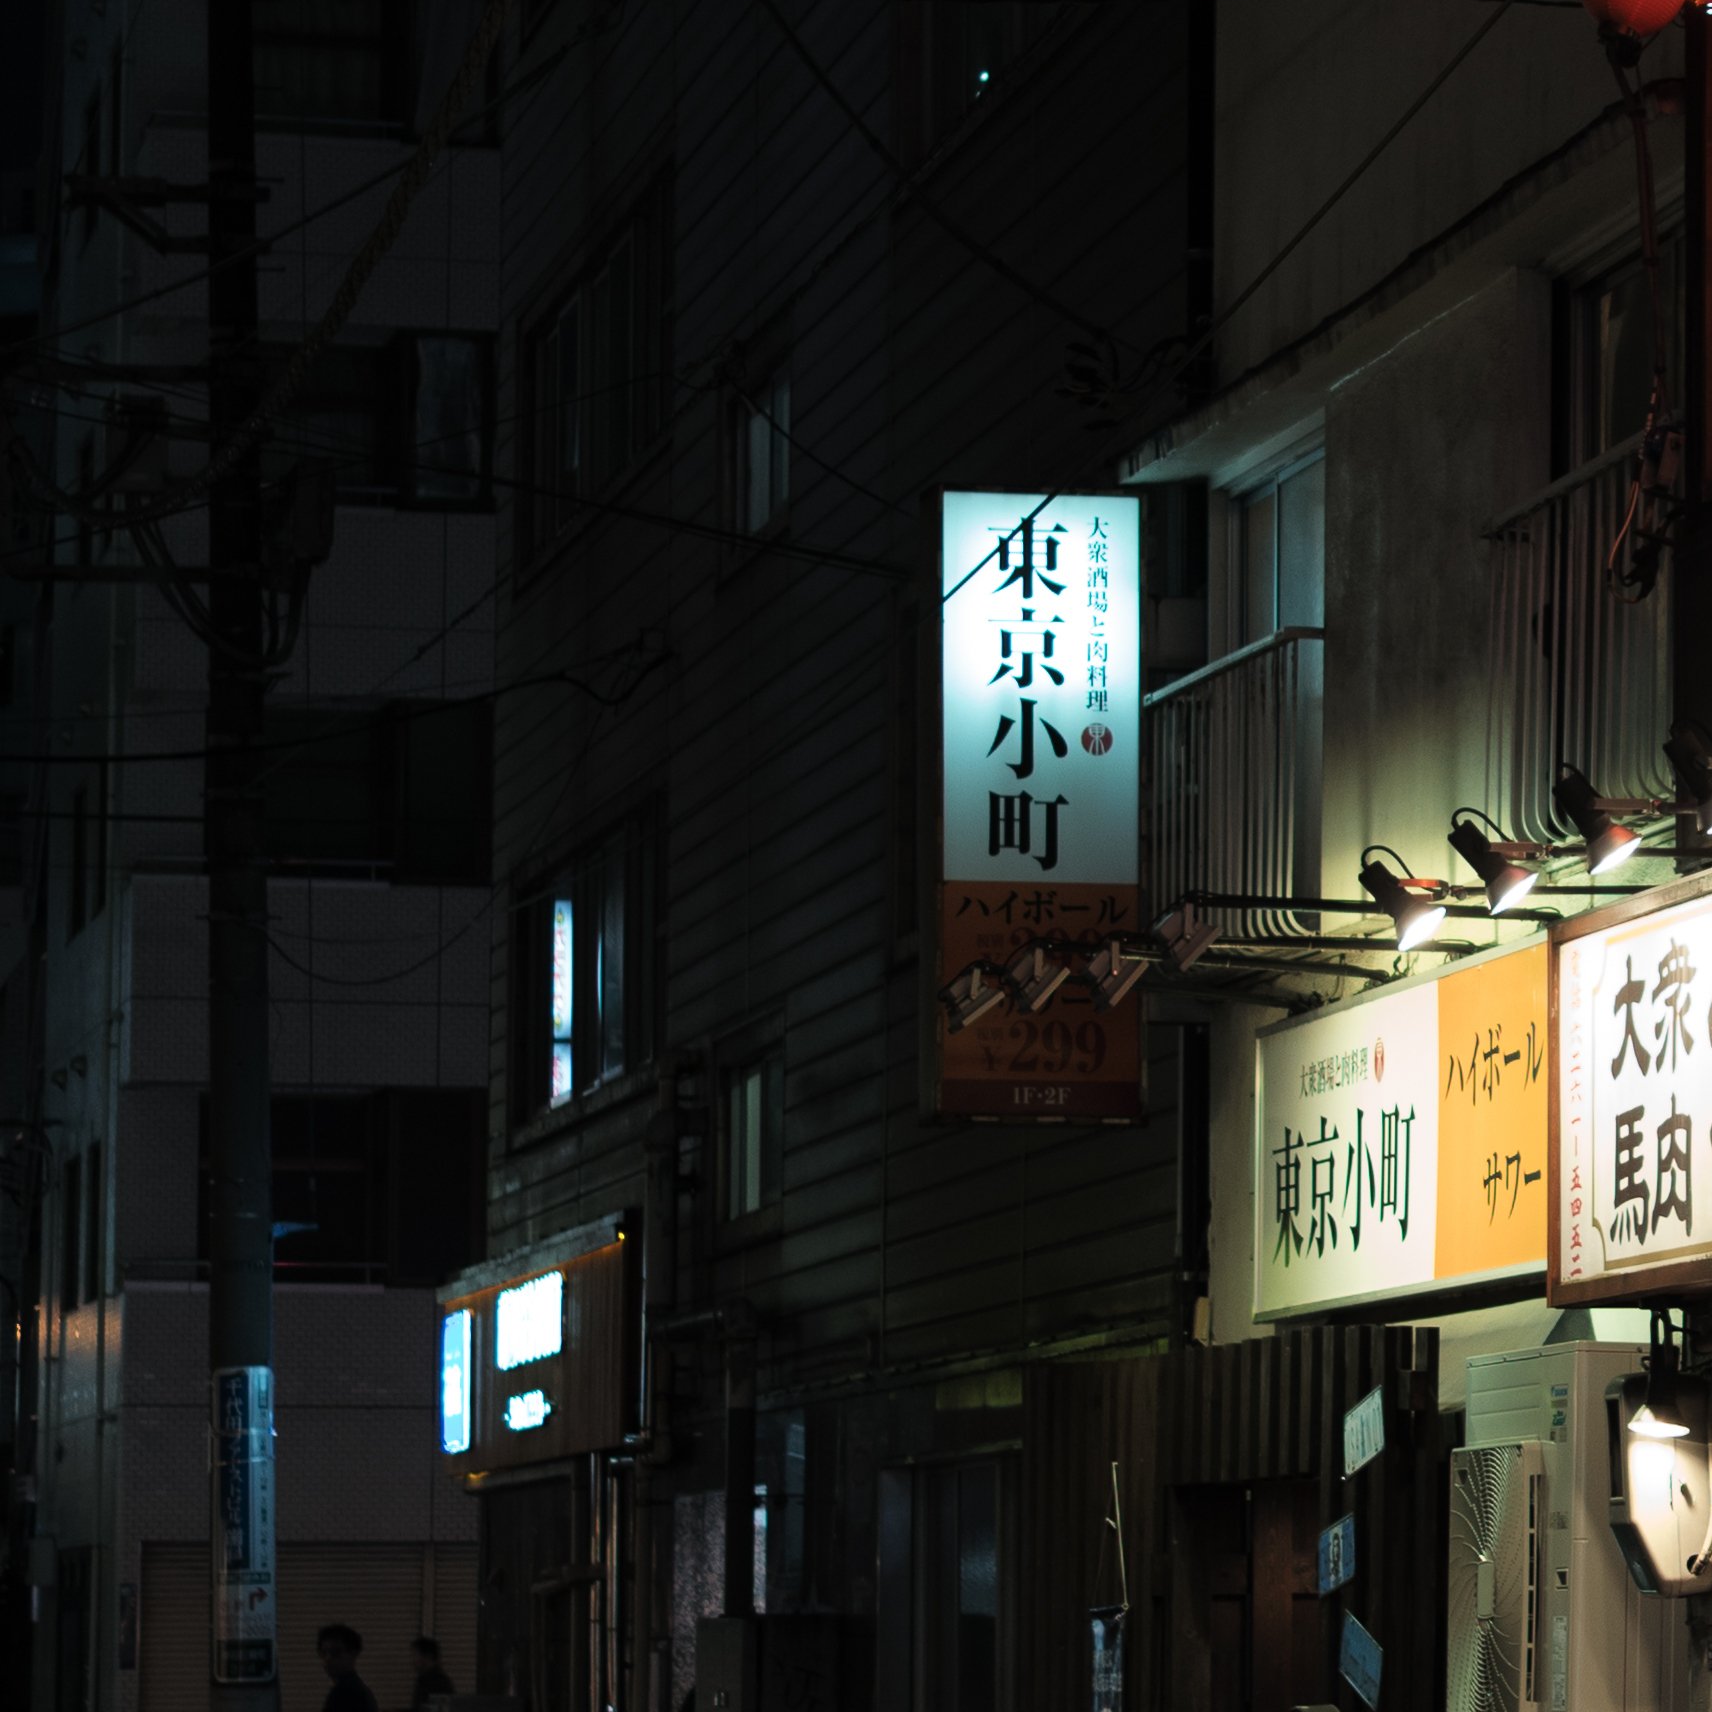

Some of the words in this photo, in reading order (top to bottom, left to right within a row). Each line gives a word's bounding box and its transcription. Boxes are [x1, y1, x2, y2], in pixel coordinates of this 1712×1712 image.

[1086, 516, 1110, 714] 大衆酒場と肉料理
[986, 516, 1070, 872] 東京小町
[956, 889, 1129, 925] ハイボール
[1299, 1046, 1369, 1101] 大衆酒場と肉料理
[1445, 1021, 1544, 1106] ハイボール
[1610, 937, 1697, 1081] 大衆
[1272, 1103, 1416, 1268] 東京小町
[1483, 1151, 1542, 1227] サワー
[1610, 1091, 1694, 1248] 馬肉
